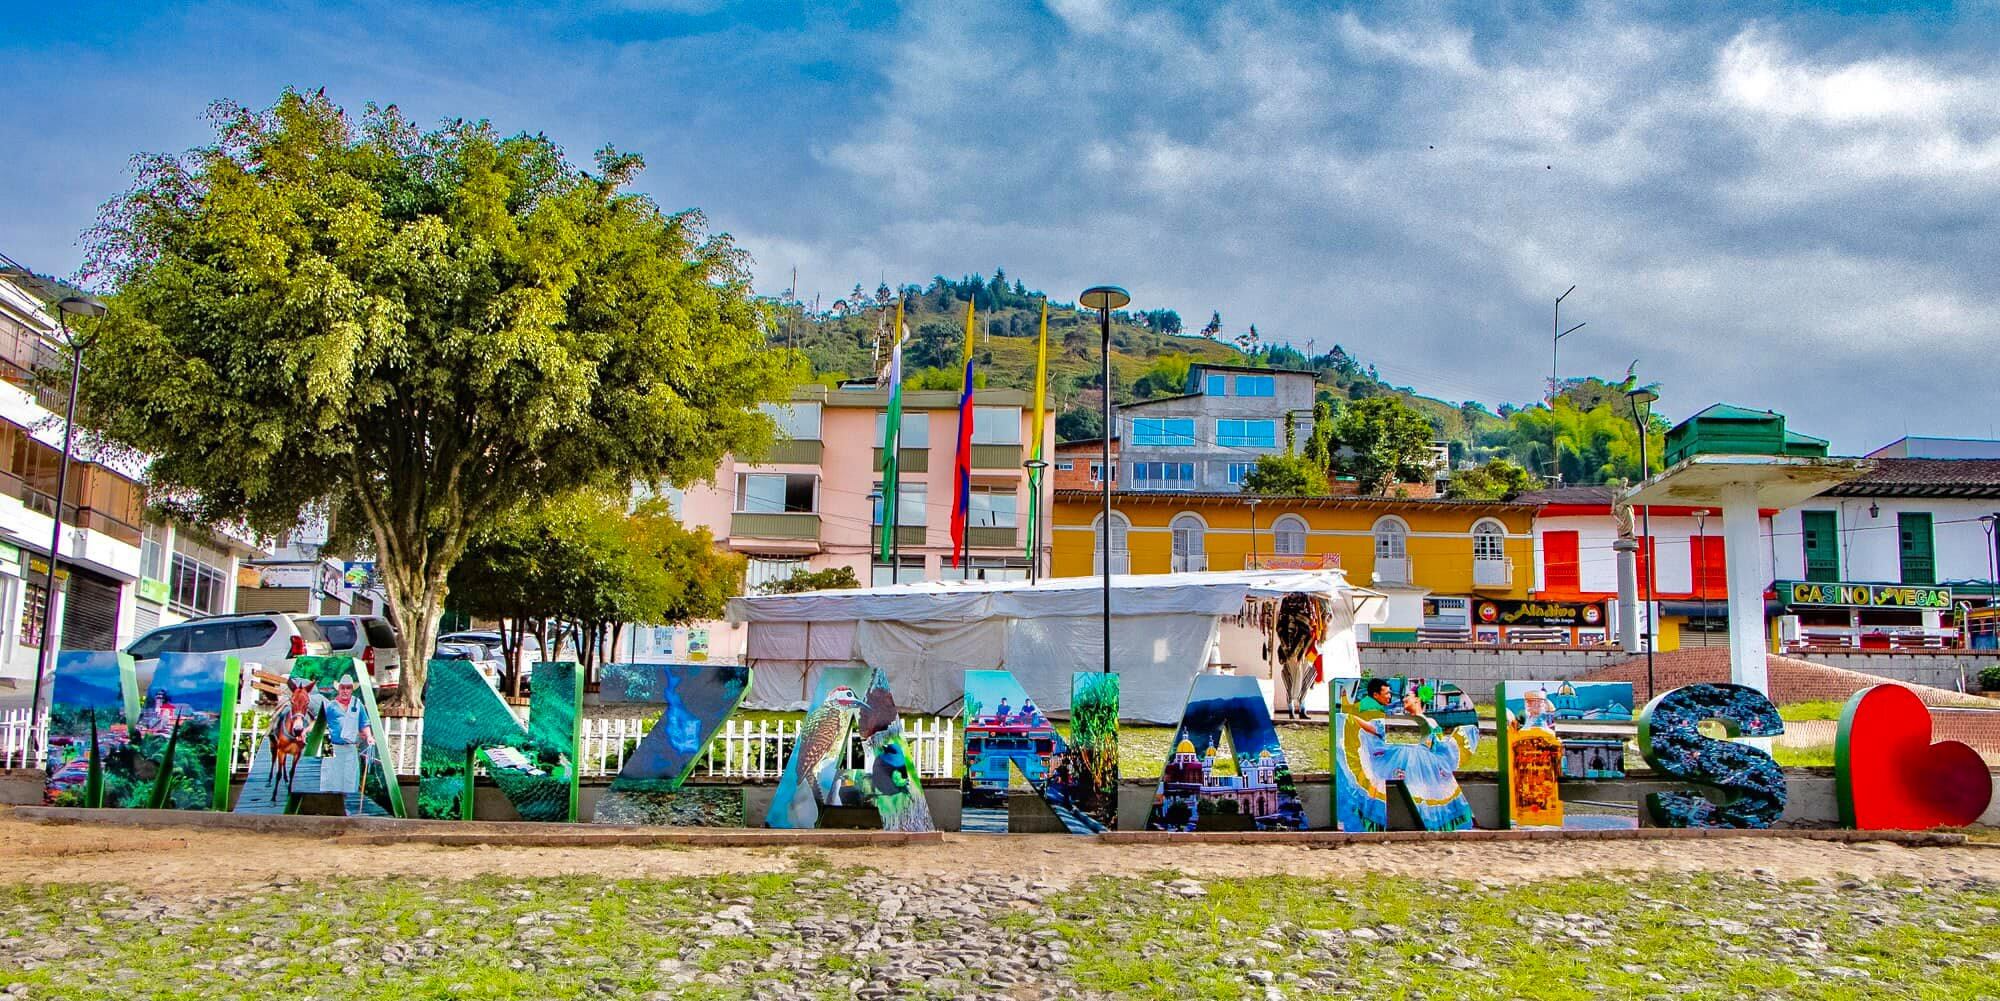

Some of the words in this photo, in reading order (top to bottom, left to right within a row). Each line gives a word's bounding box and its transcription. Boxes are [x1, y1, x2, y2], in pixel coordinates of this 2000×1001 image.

[1794, 584, 1869, 605] CASINO
[1895, 589, 1950, 607] VEGAS
[44, 651, 1787, 834] MANZANARES
